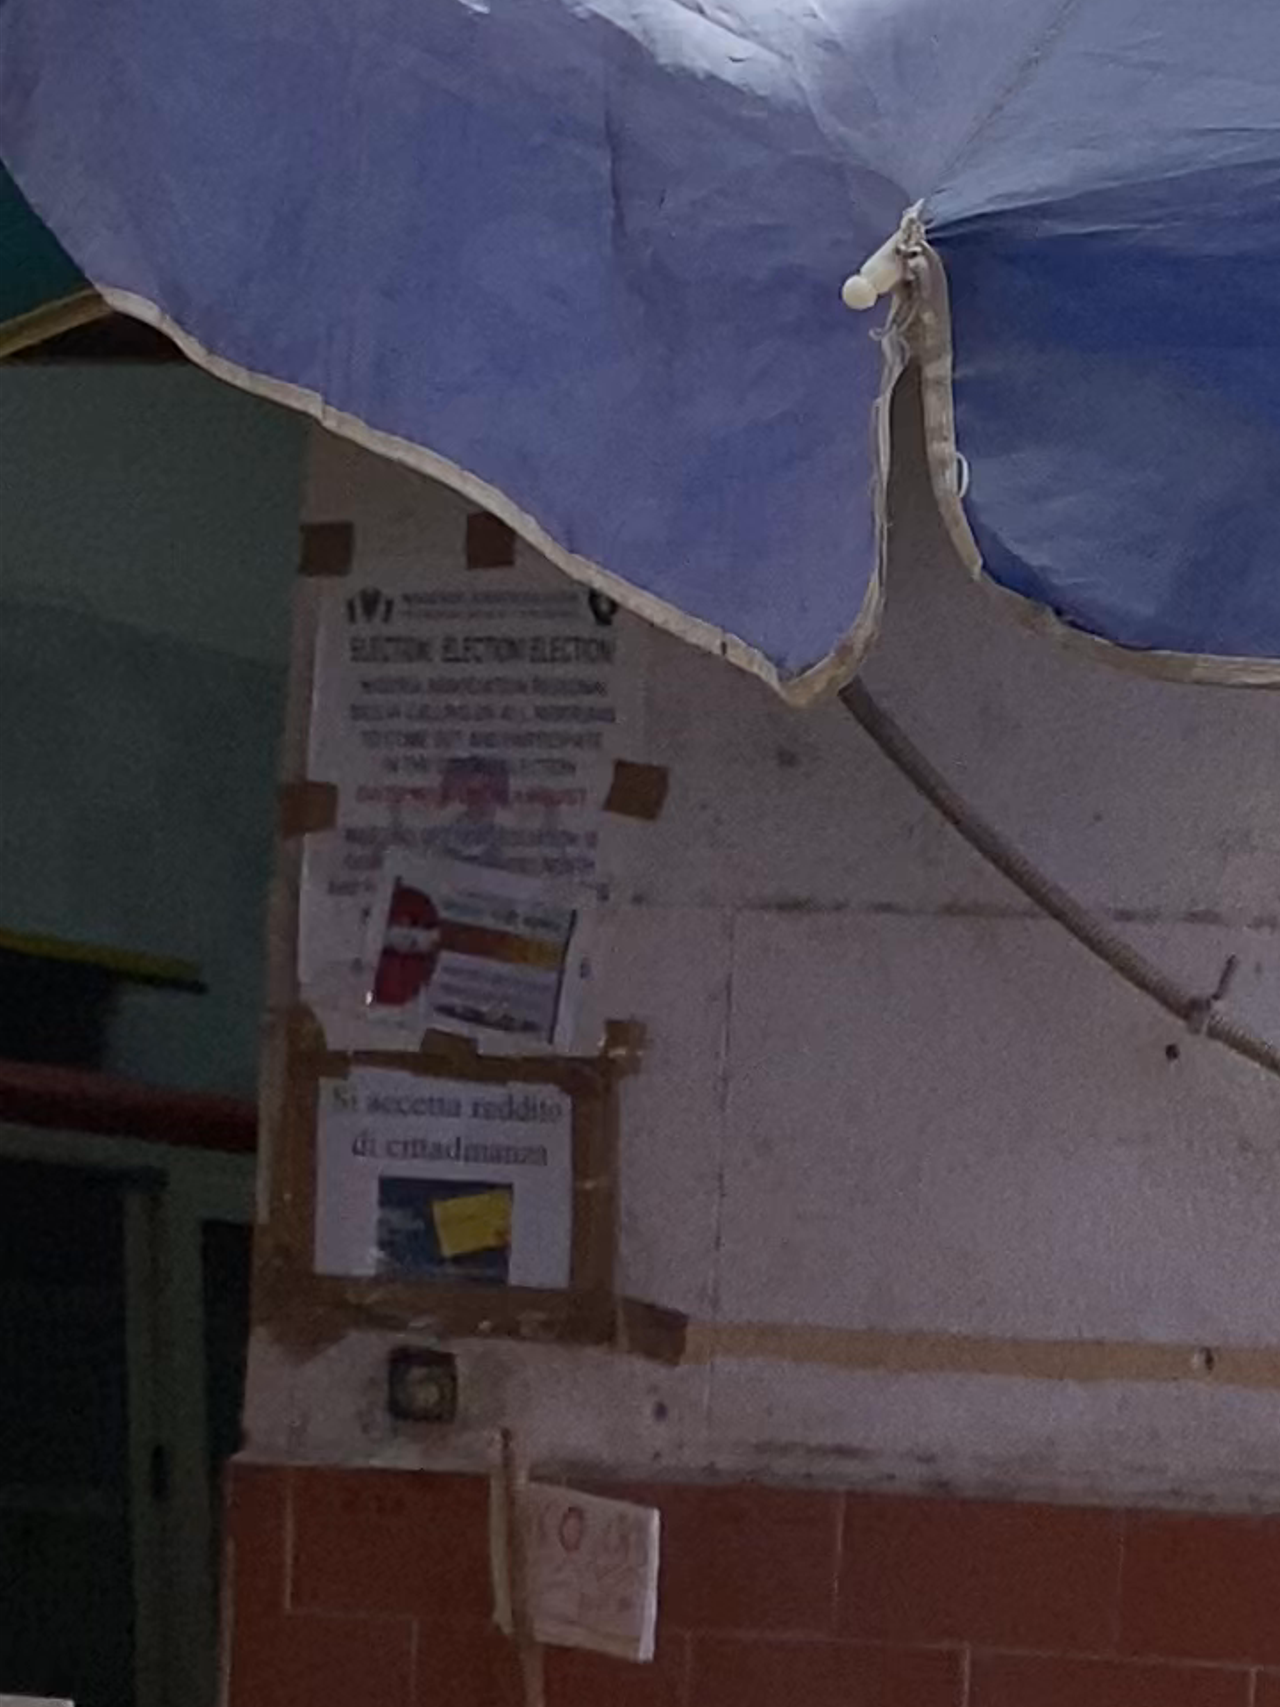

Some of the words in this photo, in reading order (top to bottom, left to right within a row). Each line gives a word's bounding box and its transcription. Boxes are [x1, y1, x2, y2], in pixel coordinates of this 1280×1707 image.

[367, 1095, 462, 1118] accetta
[472, 1094, 562, 1123] reddito
[352, 1131, 376, 1157] di
[386, 1136, 548, 1167] cittadinanza
